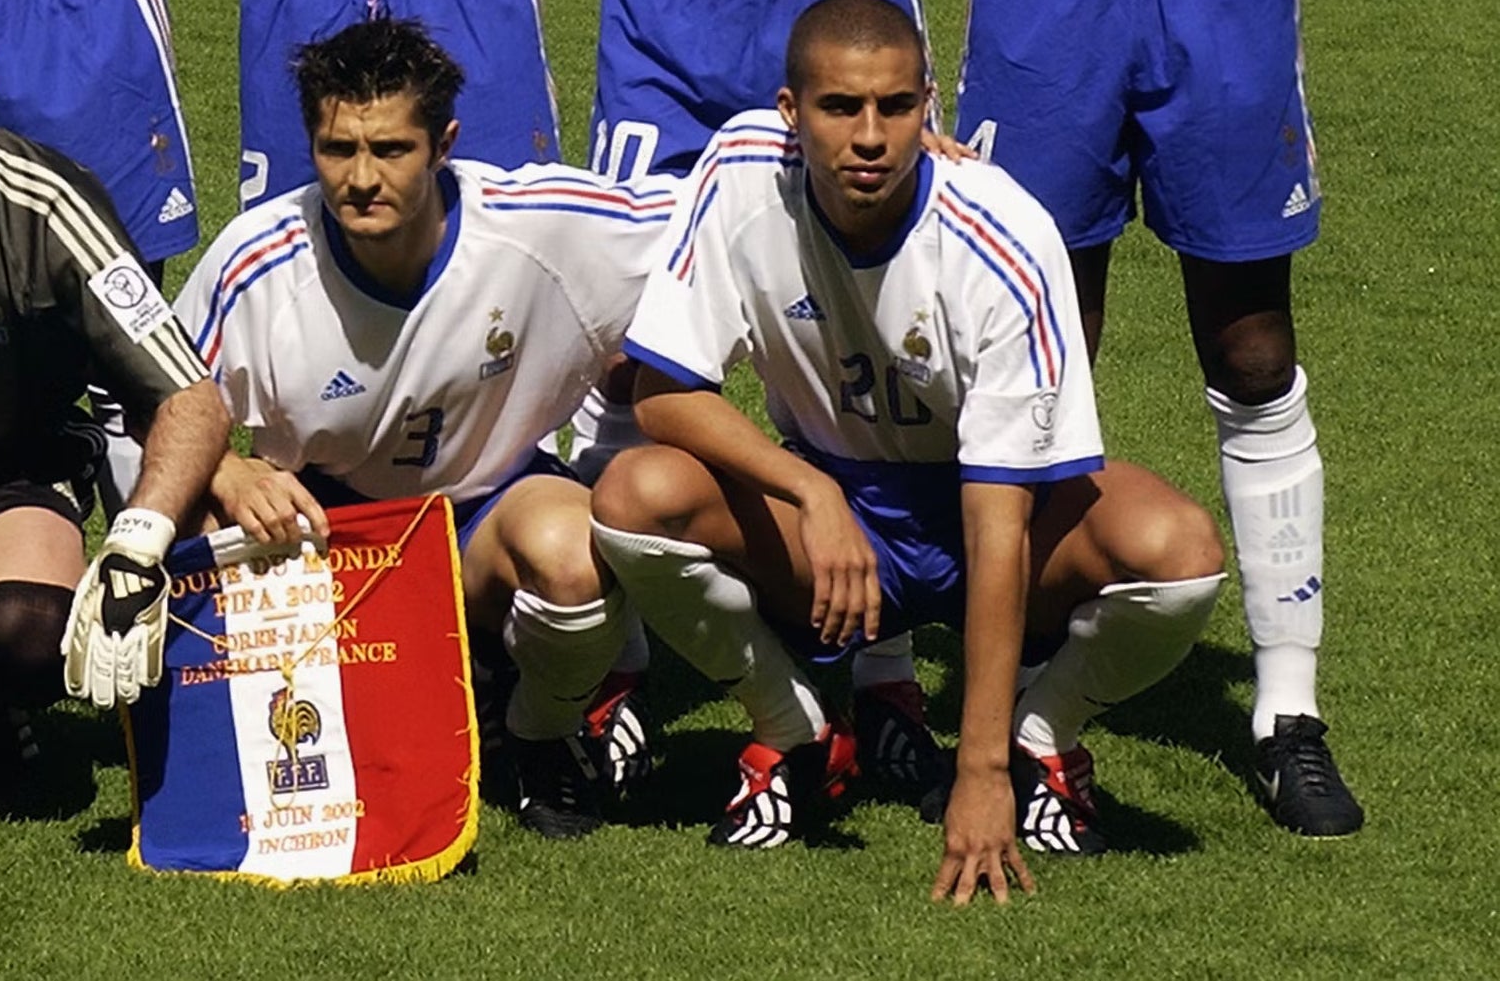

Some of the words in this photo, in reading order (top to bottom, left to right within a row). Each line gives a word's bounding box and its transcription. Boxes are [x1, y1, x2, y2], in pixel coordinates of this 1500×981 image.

[391, 406, 445, 468] 3
[169, 565, 243, 599] OUPE
[303, 544, 404, 574] MONDE
[212, 587, 276, 618] FIFA
[285, 580, 346, 608] 2002
[303, 641, 398, 669] FRANCE
[262, 804, 315, 829] JUIN
[320, 798, 366, 823] 2002
